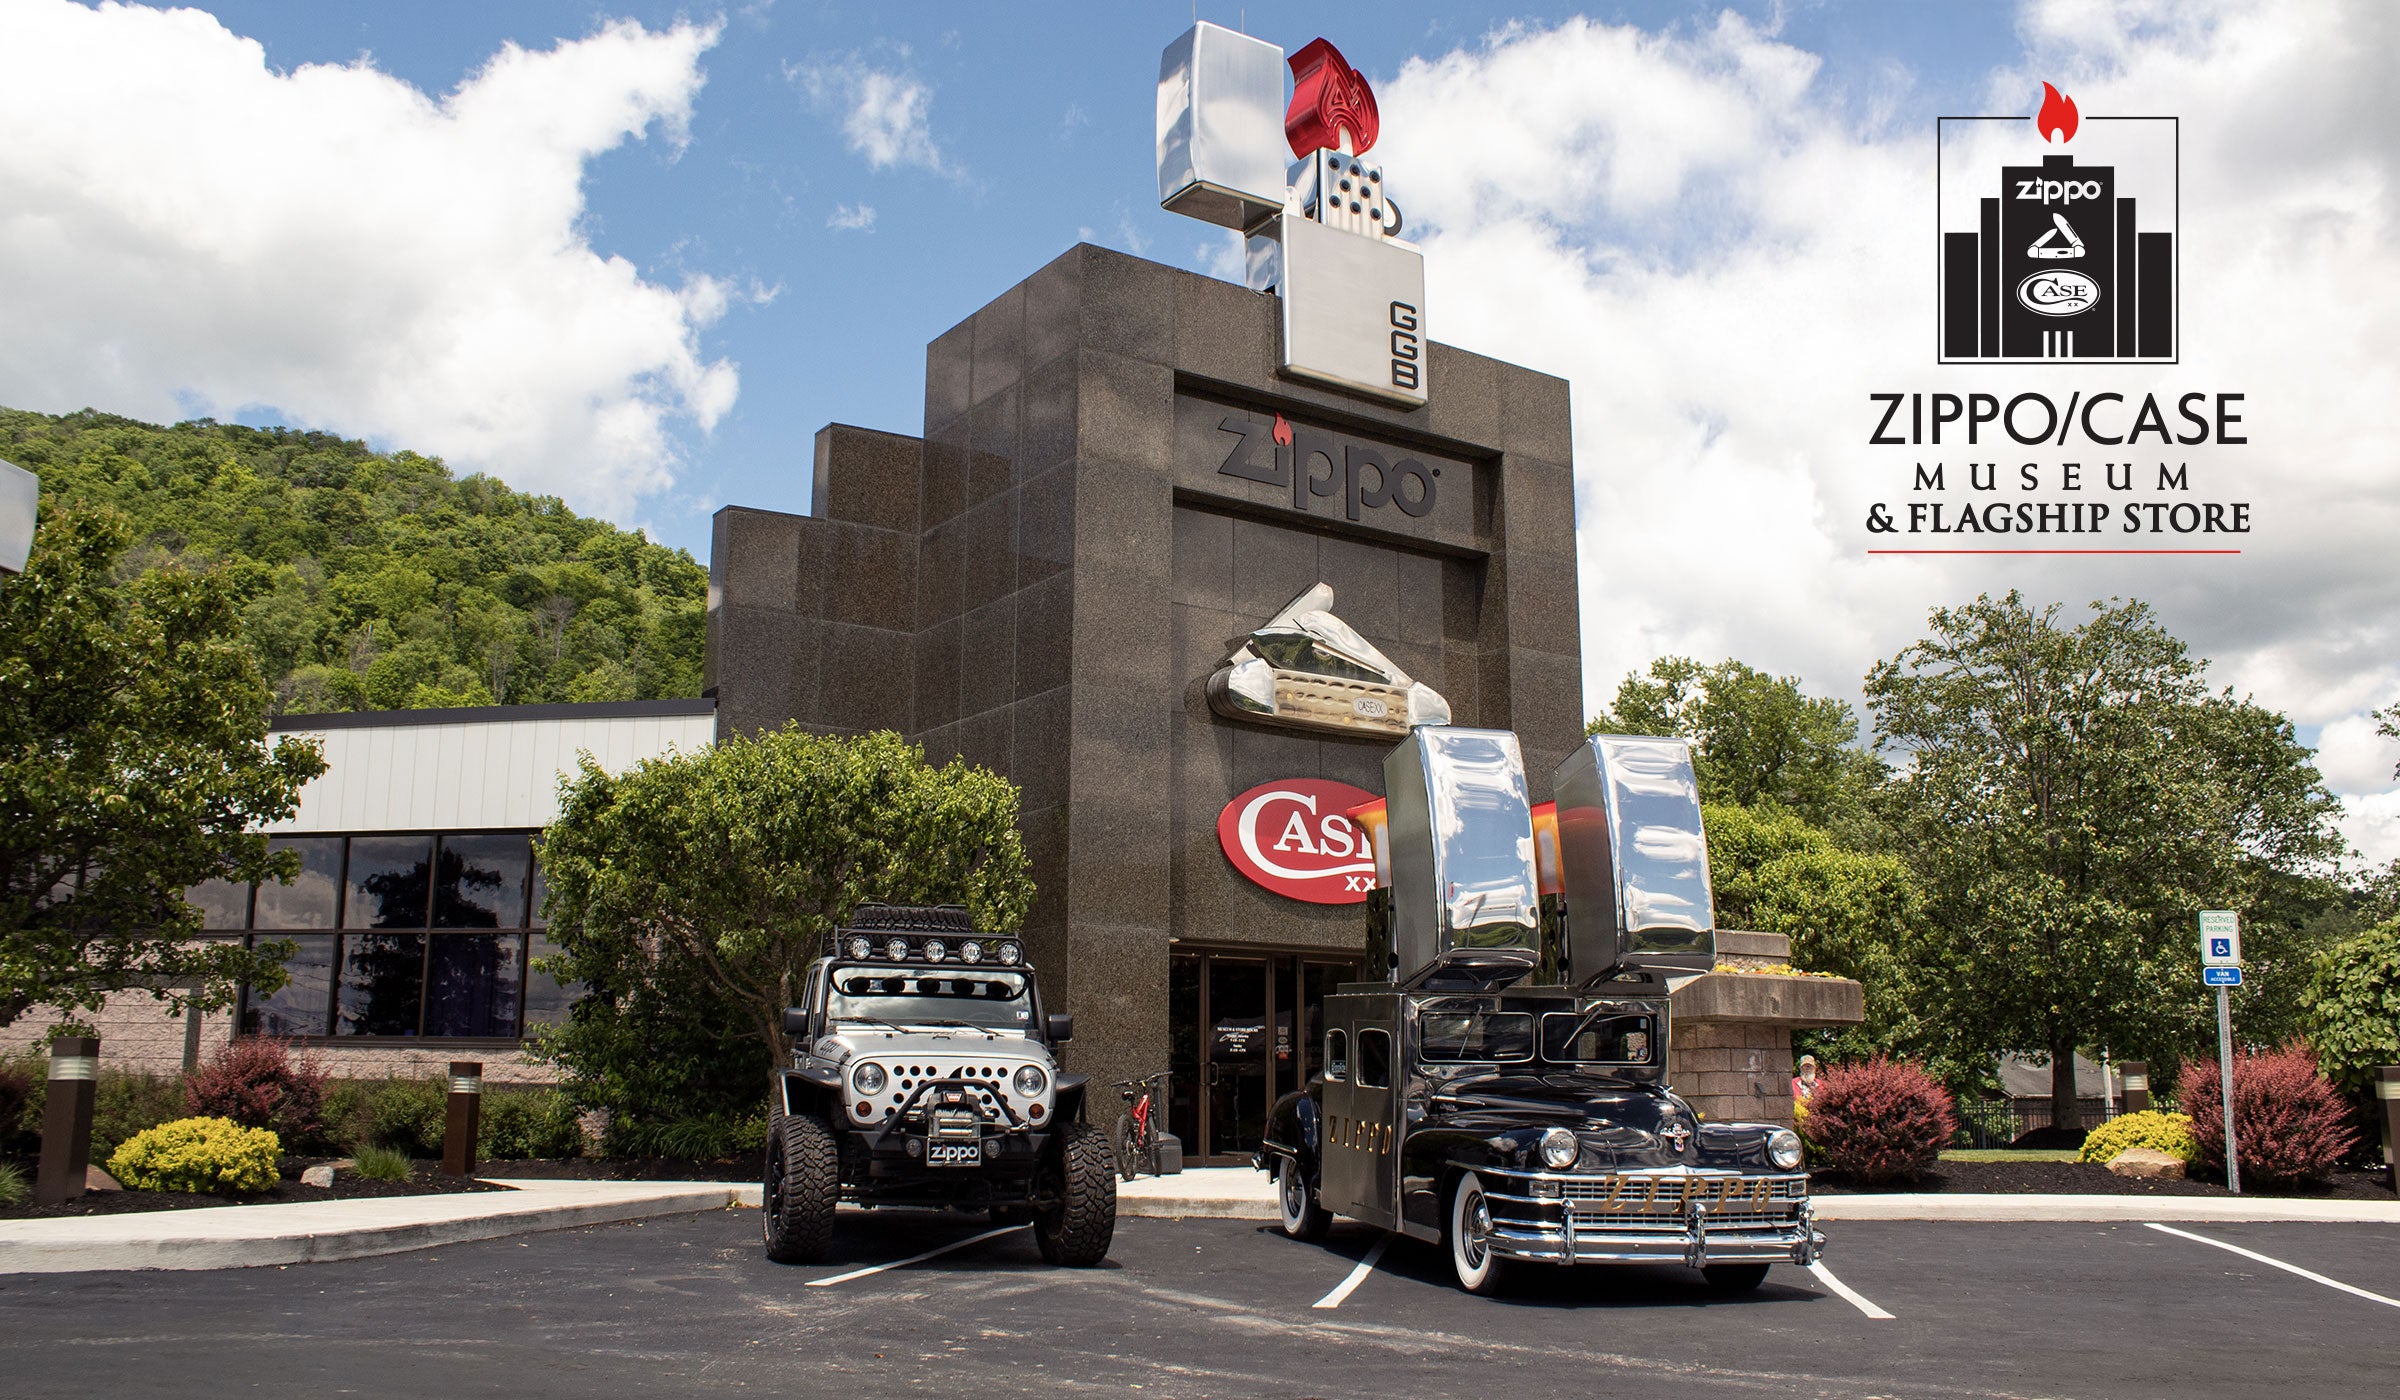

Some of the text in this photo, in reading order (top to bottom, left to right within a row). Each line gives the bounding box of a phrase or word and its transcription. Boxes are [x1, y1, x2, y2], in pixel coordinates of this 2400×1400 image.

[1390, 301, 1419, 390] GGB
[1218, 413, 1439, 521] zippo
[2206, 925, 2233, 933] PARKING
[931, 1145, 978, 1161] zippo
[1329, 1116, 1393, 1154] ZIPPO
[1601, 1175, 1773, 1213] ZIPPO
